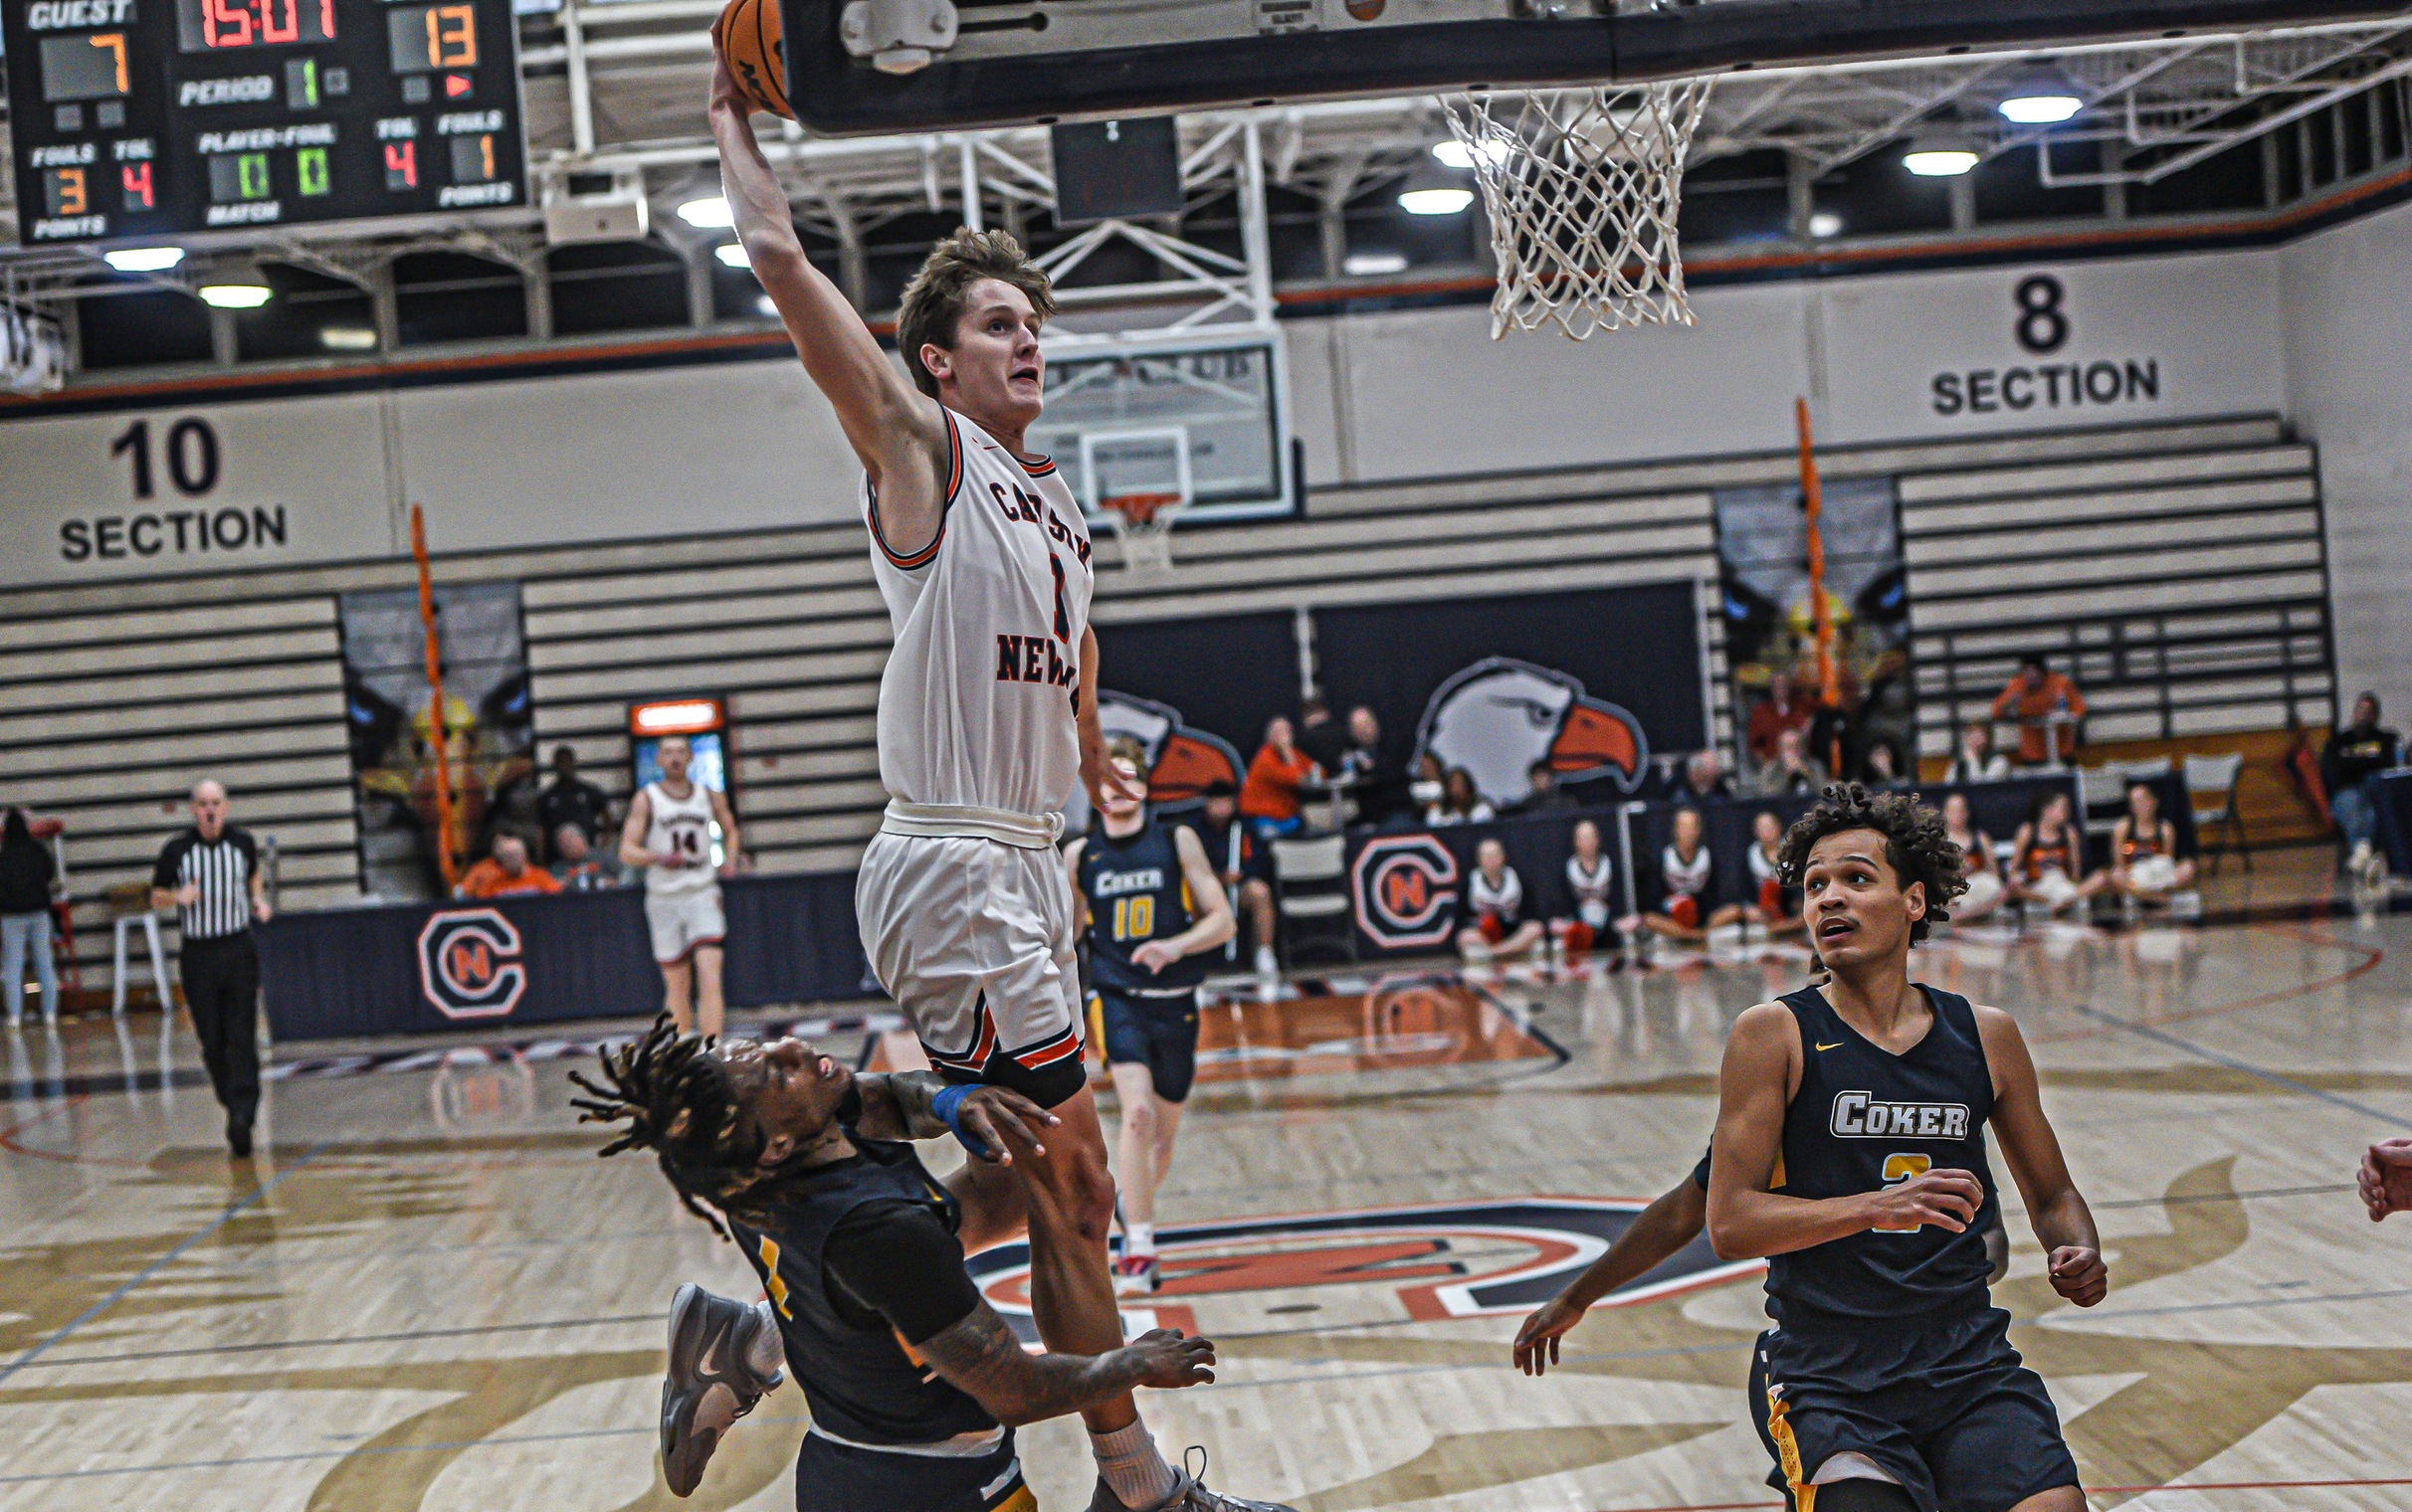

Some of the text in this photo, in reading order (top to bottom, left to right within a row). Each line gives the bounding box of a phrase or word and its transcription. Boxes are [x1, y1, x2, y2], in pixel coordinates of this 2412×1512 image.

[28, 0, 131, 30] GUEST
[426, 5, 477, 68] 13
[89, 33, 125, 93] 7
[303, 60, 317, 106] 1
[179, 75, 274, 106] PERIOD
[437, 109, 503, 135] FOULS
[31, 142, 97, 167] FOULS
[238, 152, 268, 198] 0
[298, 147, 327, 196] 0
[385, 139, 417, 187] 4
[480, 133, 495, 179] 1
[58, 167, 87, 215] 3
[122, 162, 153, 207] 4
[439, 180, 513, 208] POINTS
[33, 214, 106, 240] POINTS
[2015, 273, 2070, 354] 8
[1930, 356, 2160, 417] SECTION
[110, 416, 221, 498] 10
[60, 502, 288, 562] SECTION
[1049, 551, 1070, 645] 1
[672, 829, 699, 854] 14
[1112, 894, 1156, 942] 10
